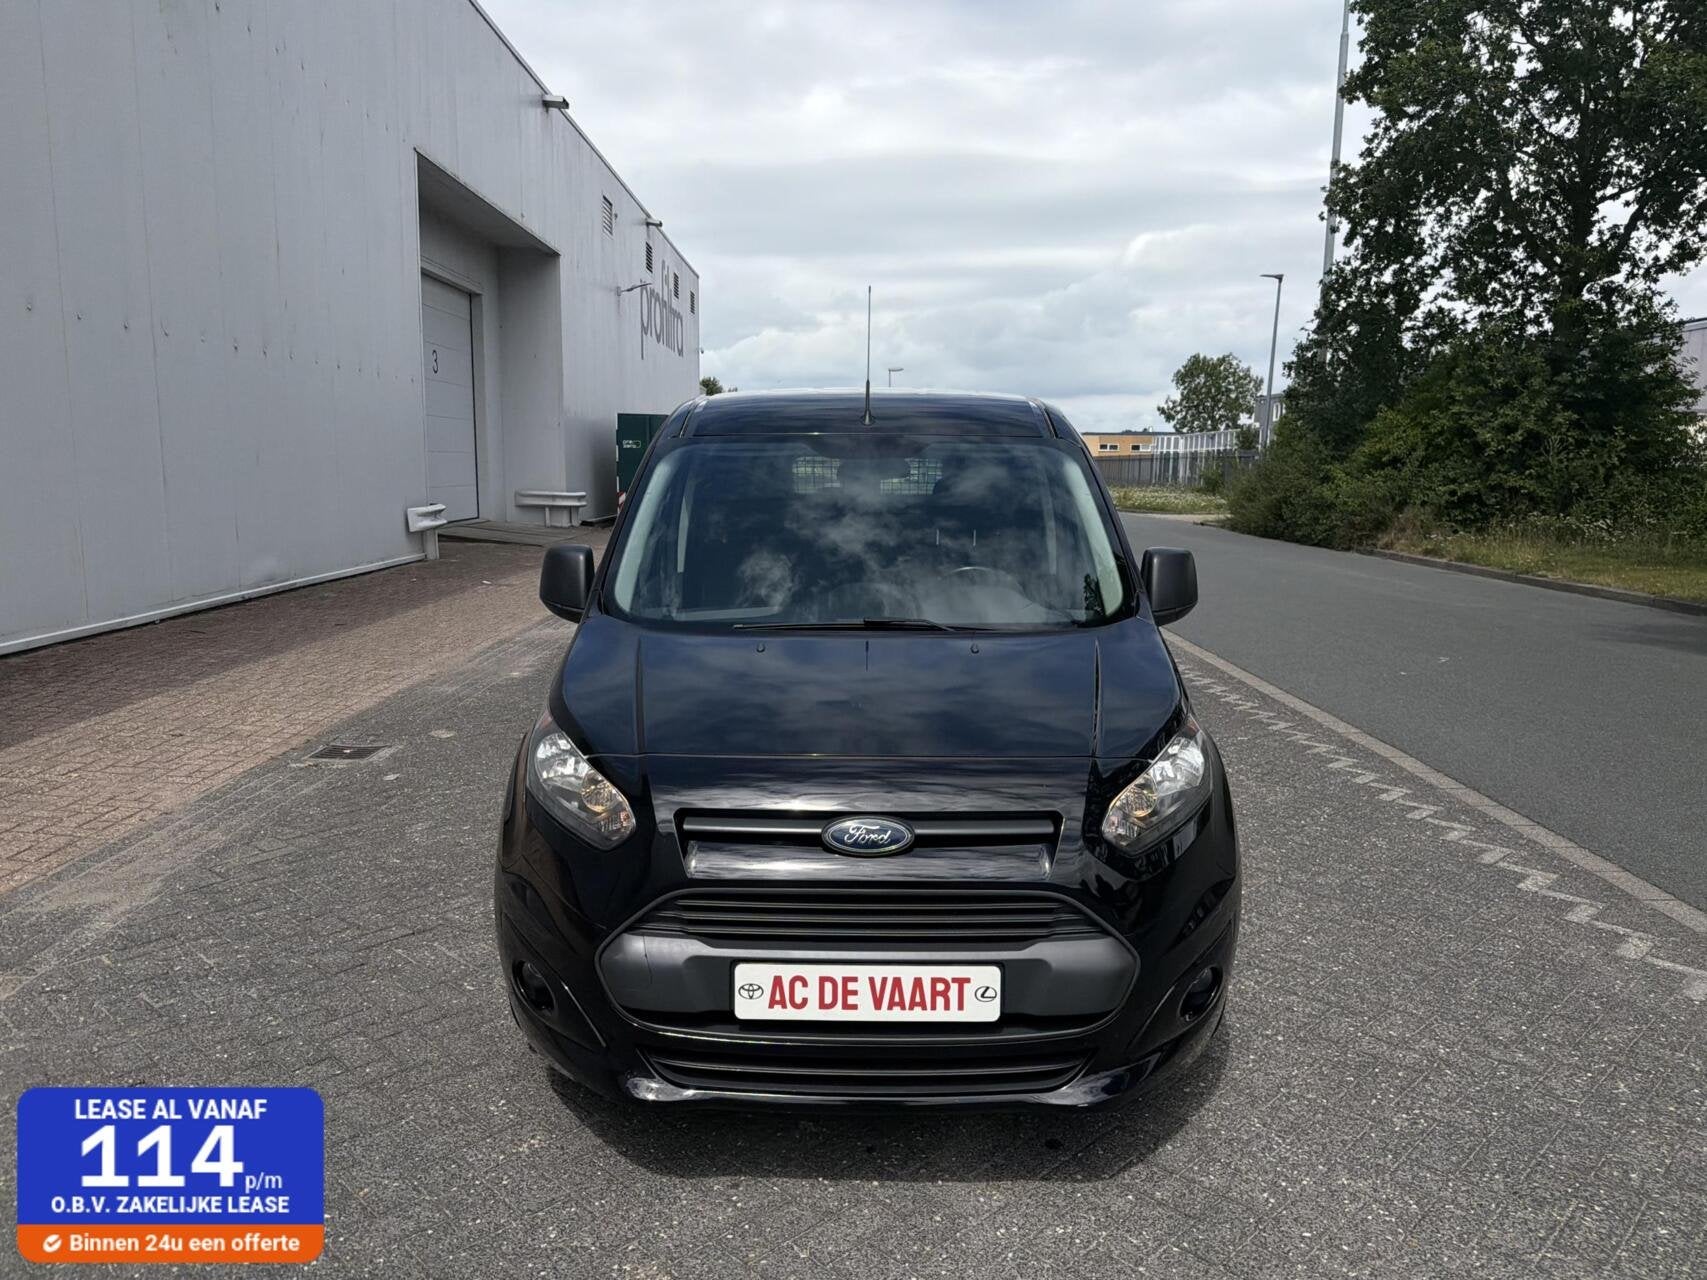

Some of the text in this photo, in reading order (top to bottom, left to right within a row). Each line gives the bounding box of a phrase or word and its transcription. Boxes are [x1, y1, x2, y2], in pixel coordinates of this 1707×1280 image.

[640, 259, 684, 361] profiltra
[432, 349, 439, 374] 3
[844, 825, 891, 845] Ford
[768, 975, 971, 1012] AC DE VAART
